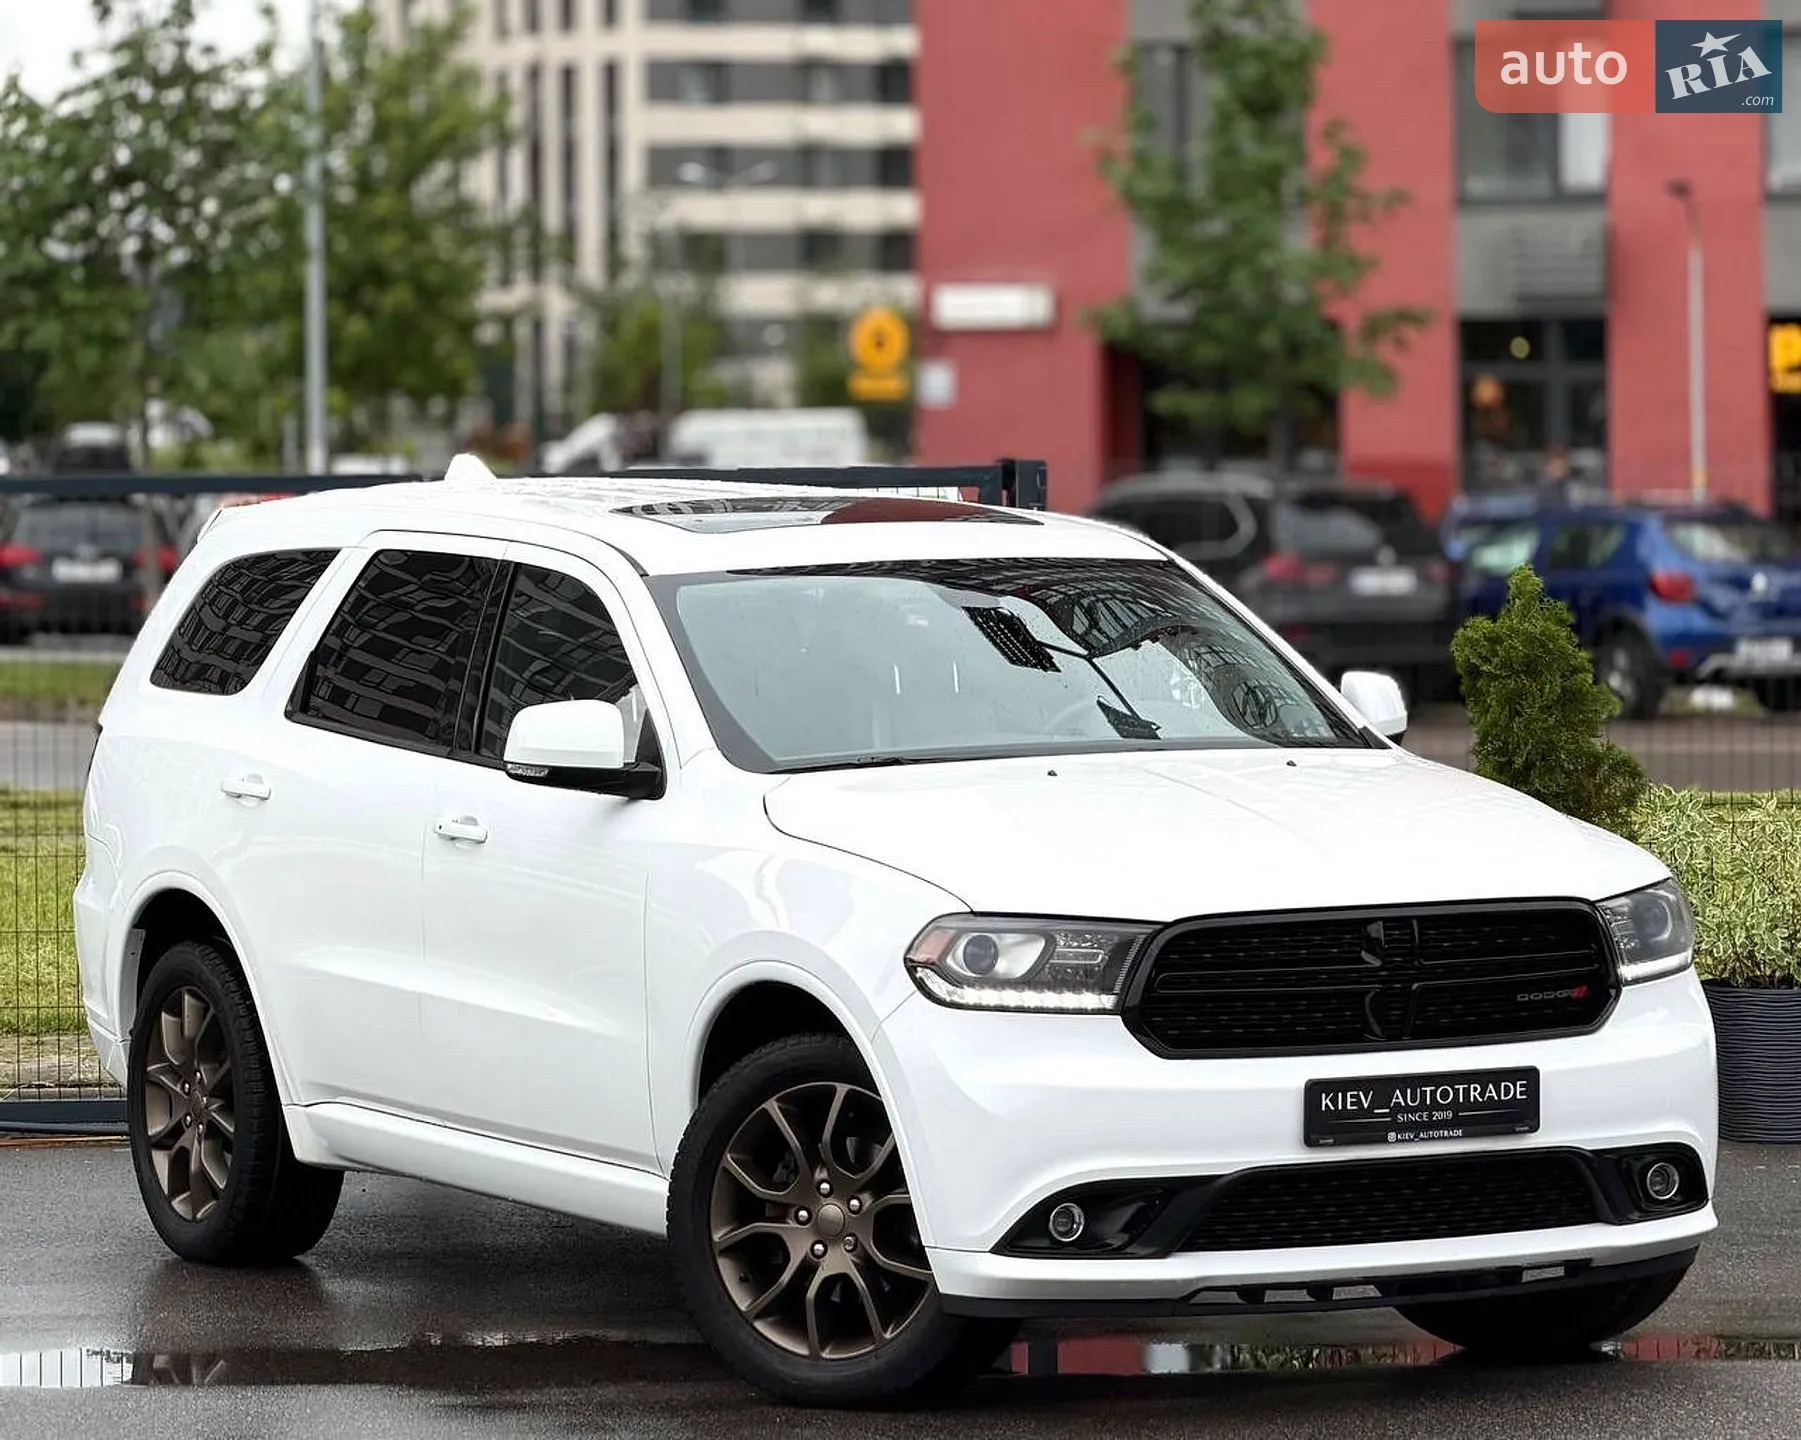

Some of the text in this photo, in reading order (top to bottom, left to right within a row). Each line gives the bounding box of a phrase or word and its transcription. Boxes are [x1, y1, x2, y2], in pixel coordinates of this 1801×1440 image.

[1321, 1080, 1528, 1113] KIEV_AUTOTRADE
[1397, 1110, 1453, 1122] SINCE 2019
[1397, 1129, 1464, 1141] KIEV_AUTOTRADE
